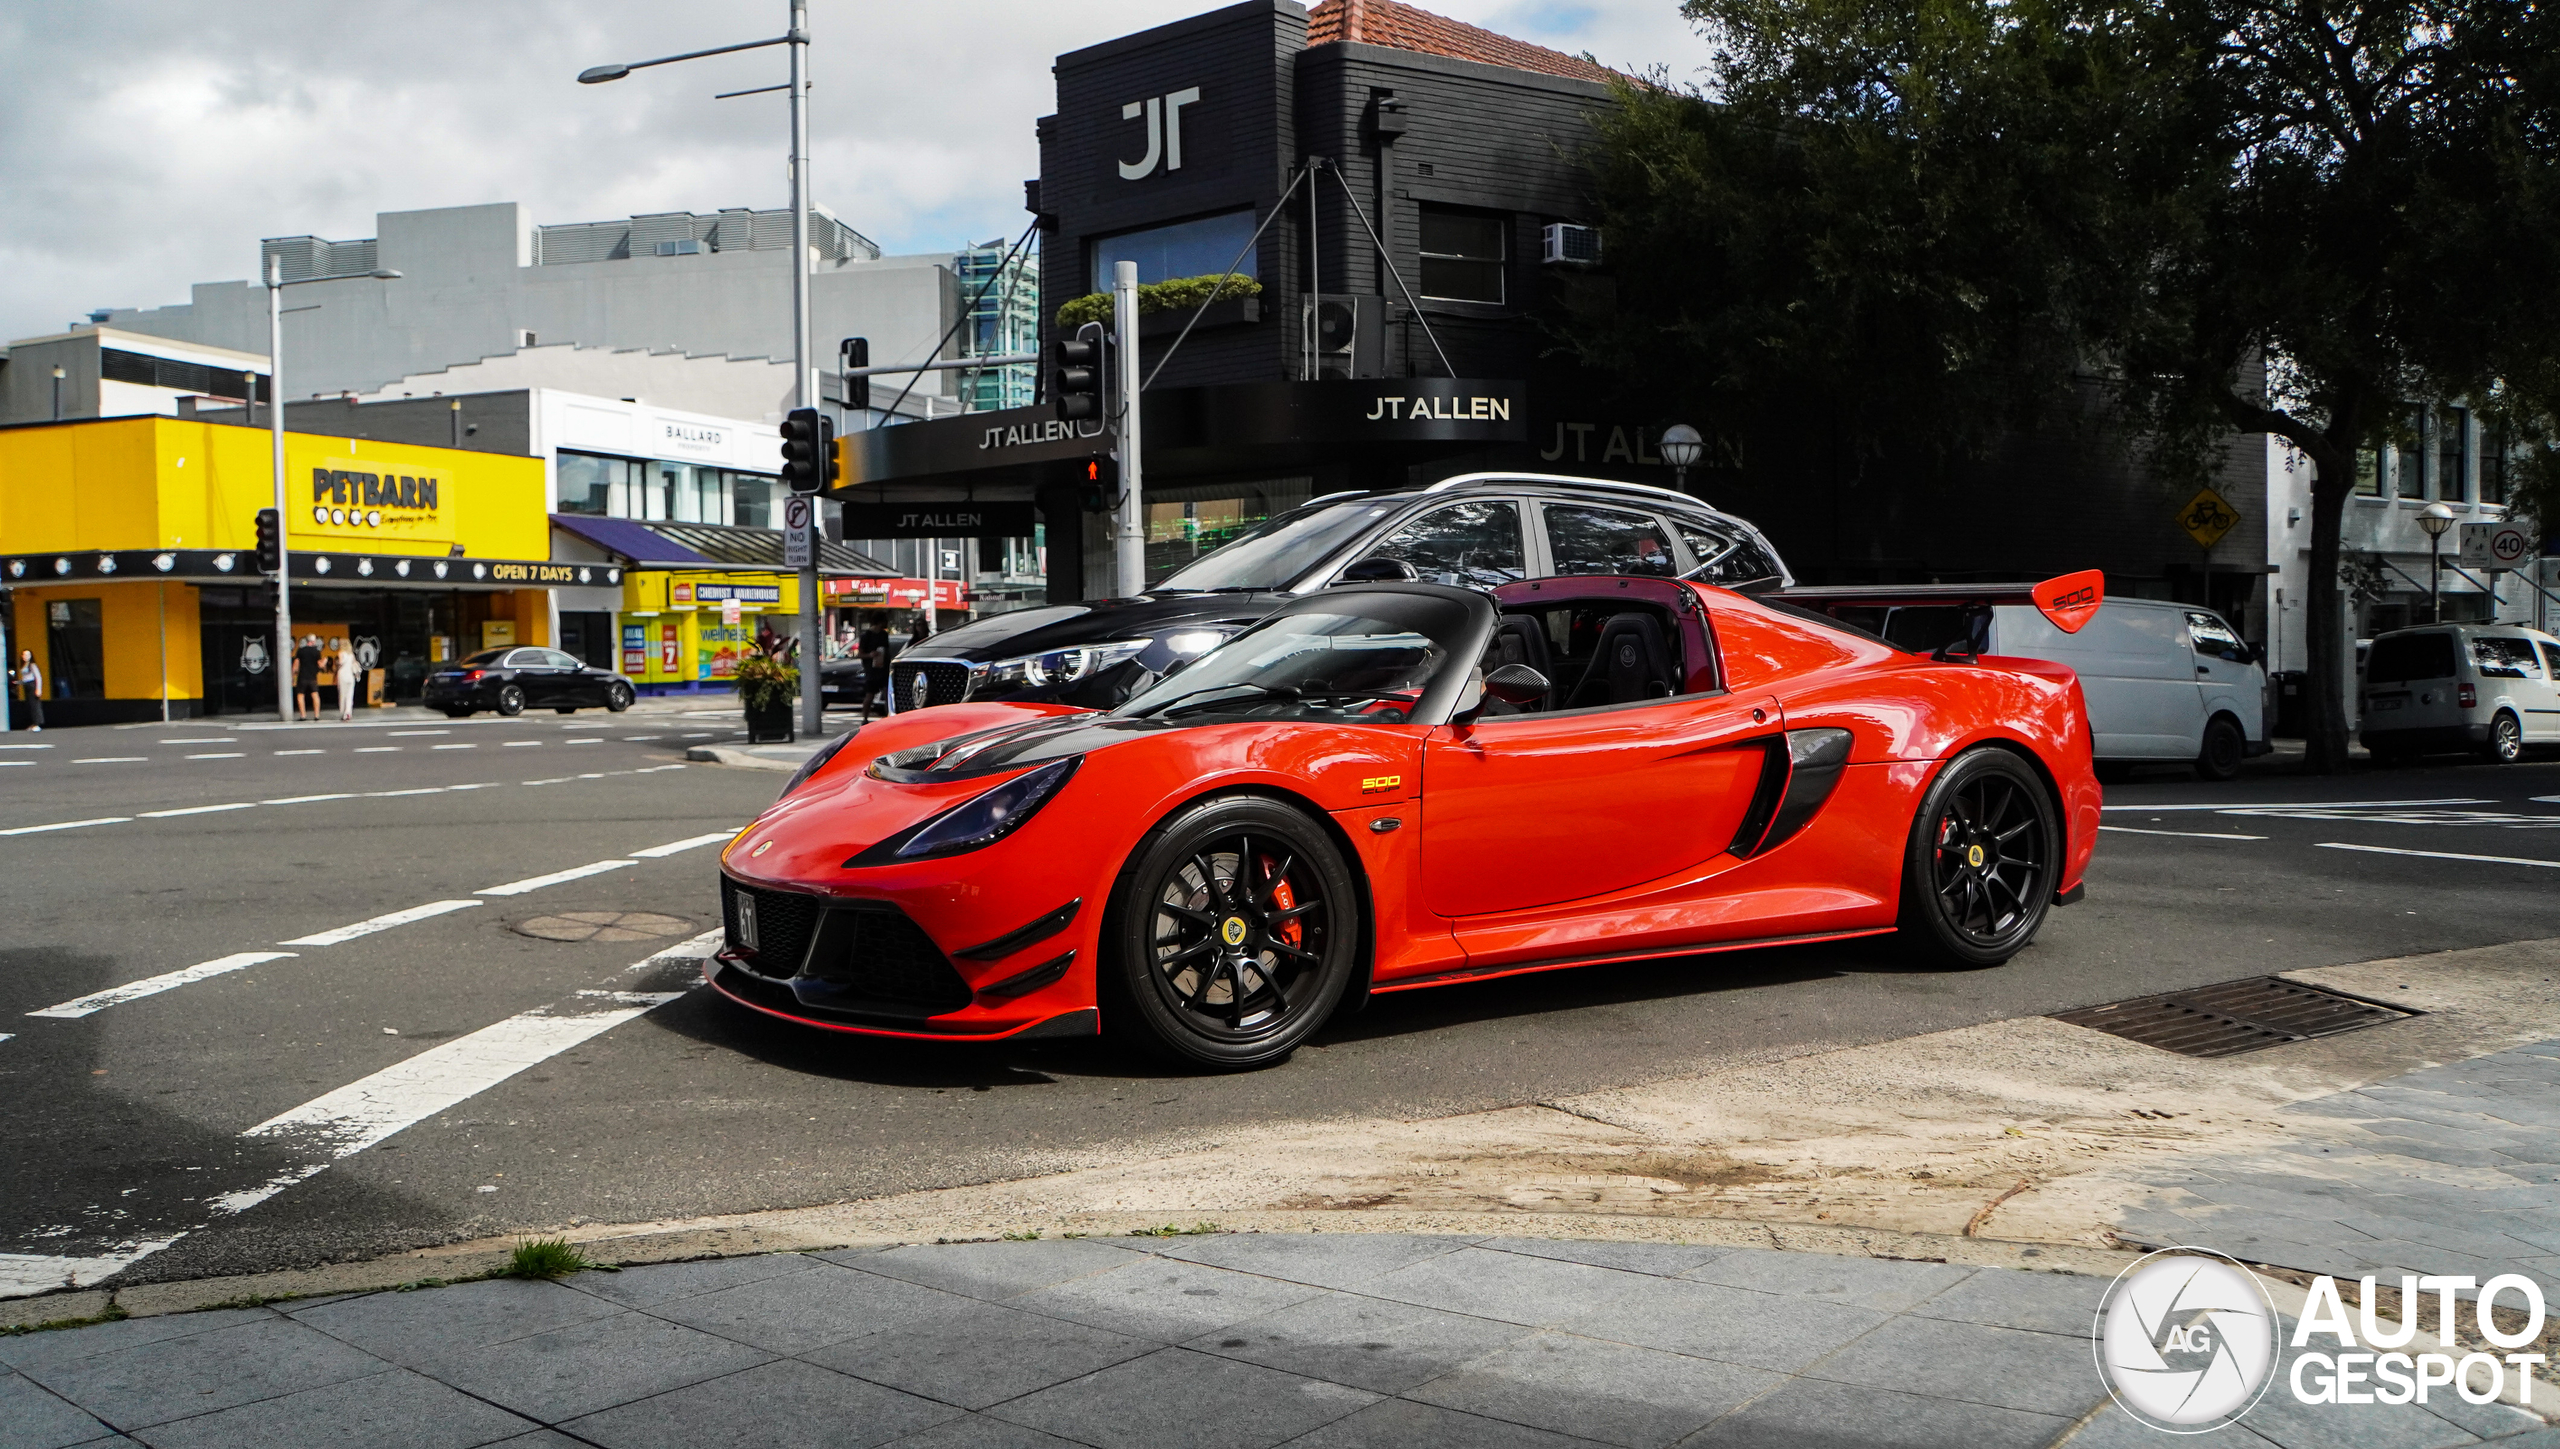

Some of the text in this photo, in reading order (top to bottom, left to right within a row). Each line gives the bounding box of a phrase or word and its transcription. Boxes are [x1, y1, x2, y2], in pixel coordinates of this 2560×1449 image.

[1119, 86, 1200, 181] JT
[1367, 397, 1510, 421] JT ALLEN
[666, 425, 722, 444] BALLARD
[978, 420, 1074, 450] JT ALLEN
[1540, 421, 1744, 470] JT ALN
[313, 468, 438, 510] PETBARN
[897, 513, 981, 528] JT ALLEN
[789, 532, 805, 543] NO
[2497, 537, 2520, 553] 40
[493, 564, 574, 582] OPEN 7 DAYS
[697, 585, 732, 599] CHEMIST
[733, 587, 780, 602] WAREHOUSE
[2053, 586, 2094, 611] 500
[665, 647, 676, 664] 7
[1362, 775, 1401, 789] 500
[1362, 786, 1400, 795] CUP
[1280, 891, 1294, 925] LOTS
